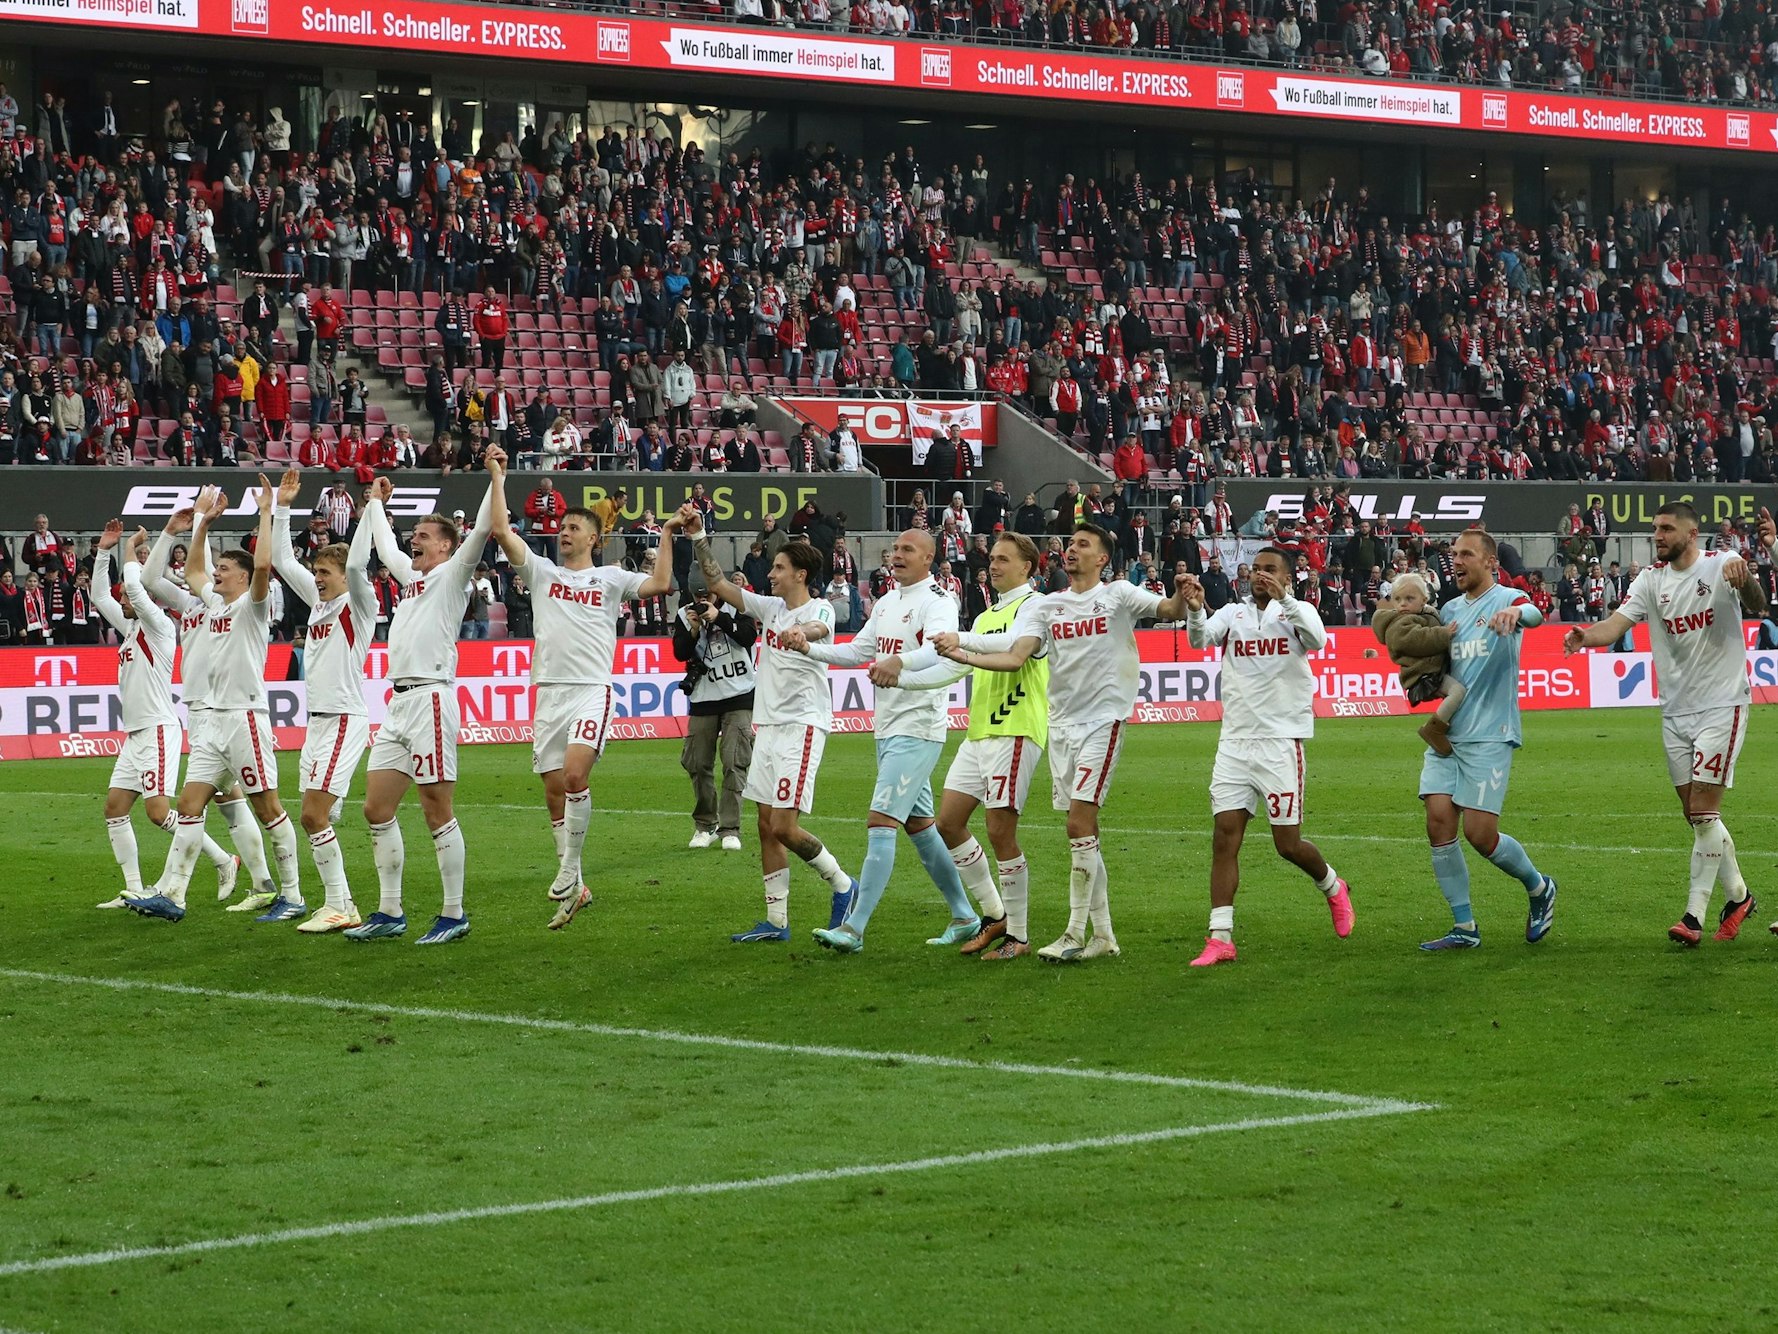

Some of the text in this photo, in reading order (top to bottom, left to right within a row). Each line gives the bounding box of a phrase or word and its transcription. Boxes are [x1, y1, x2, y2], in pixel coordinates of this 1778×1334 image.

[157, 0, 187, 17] hat.
[301, 5, 567, 50] Schnell. Schneller. EXPRESS.
[599, 27, 628, 53] EXPRESS
[680, 39, 885, 72] Wo Fußball immer Heimspiel hat.
[922, 53, 950, 78] EXPRESS
[977, 61, 1192, 98] Schnell. Schneller. EXPRESS.
[1218, 76, 1243, 100] EXPRESS
[1284, 87, 1453, 116] Wo Fußball immer Heimspiel hat.
[1483, 98, 1507, 121] EXPRESS
[1528, 104, 1707, 138] Schnell. Schneller. EXPRESS.
[1727, 118, 1749, 140] EXPRESS
[548, 582, 603, 607] REWE
[1051, 616, 1108, 641] REWE
[1662, 608, 1715, 635] REWE
[875, 636, 904, 655] EWE
[1234, 637, 1290, 657] REWE
[1452, 638, 1490, 660] EWE
[574, 718, 598, 741] 18
[240, 766, 257, 787] 6
[412, 753, 435, 777] 21
[1693, 751, 1722, 778] 24
[777, 777, 791, 801] 8
[1076, 766, 1093, 791] 7
[1267, 792, 1294, 819] 37
